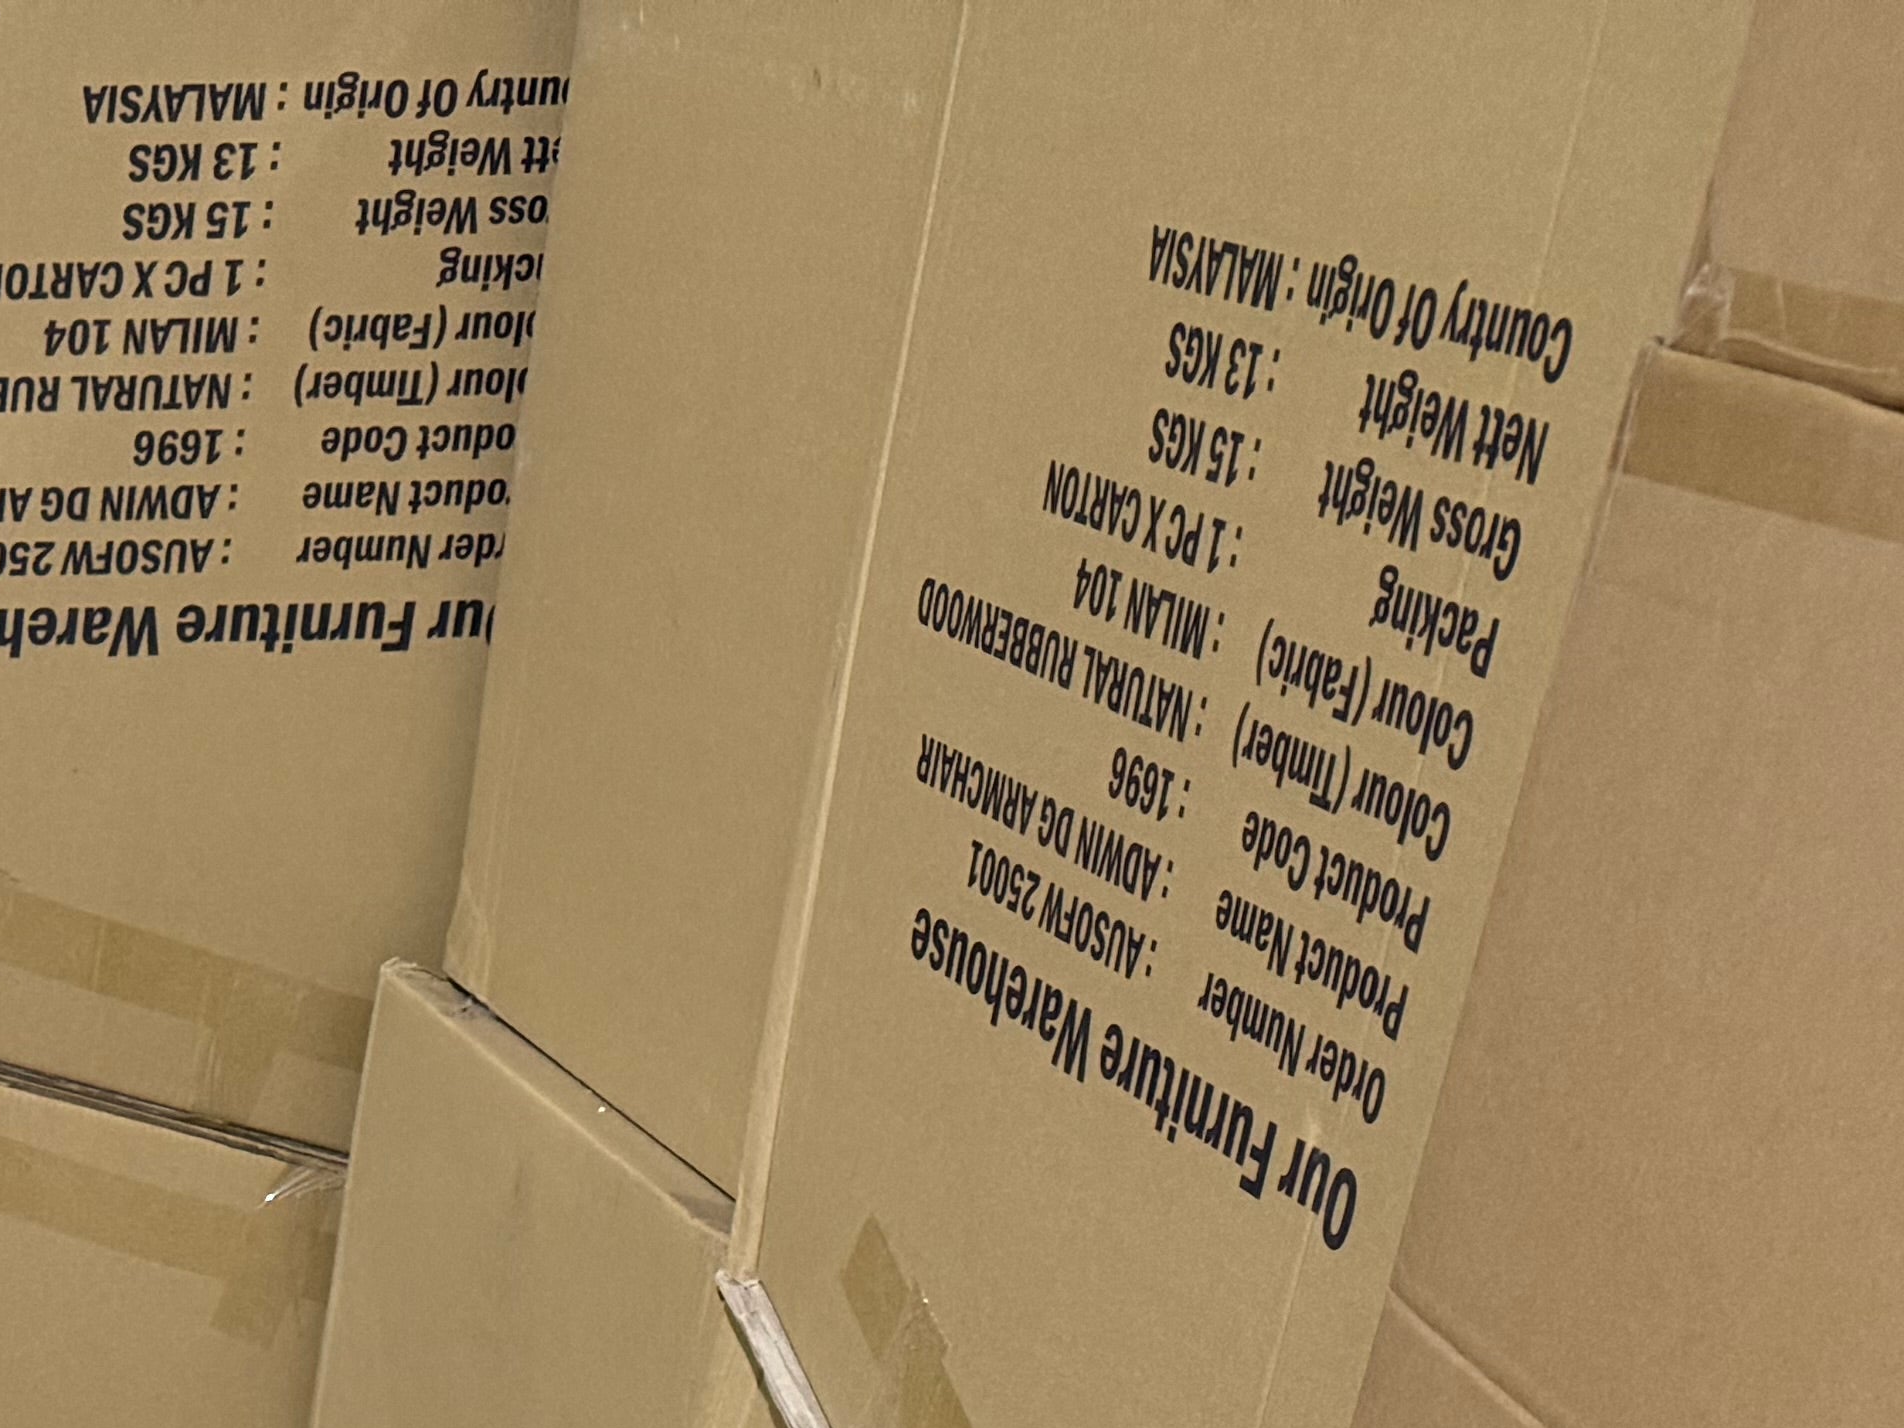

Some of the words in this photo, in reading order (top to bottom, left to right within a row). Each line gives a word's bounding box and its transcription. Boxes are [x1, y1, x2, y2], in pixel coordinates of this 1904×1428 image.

[127, 142, 201, 181] KGS
[212, 141, 257, 180] 13
[387, 129, 511, 176] Weight
[1148, 223, 1284, 311] MALAYSIA
[1306, 252, 1395, 339] Origin
[1392, 282, 1437, 350] Of
[1437, 277, 1572, 383] Country
[39, 486, 90, 521] DG
[98, 483, 220, 521] ADWIN
[301, 480, 400, 516] Name
[175, 600, 416, 653] Furniture
[1072, 556, 1122, 622] 104
[1123, 576, 1210, 659] MILAN
[1255, 616, 1371, 726] (Fabric)
[1370, 676, 1473, 770] Colour
[967, 838, 1040, 920] 25001
[1037, 880, 1146, 979] AUSOFW
[910, 906, 1092, 1082] Warehouse
[1196, 971, 1305, 1076] Number
[1099, 1022, 1277, 1199] Furniture
[1304, 1032, 1385, 1123] Order
[1276, 1136, 1357, 1250] Our
